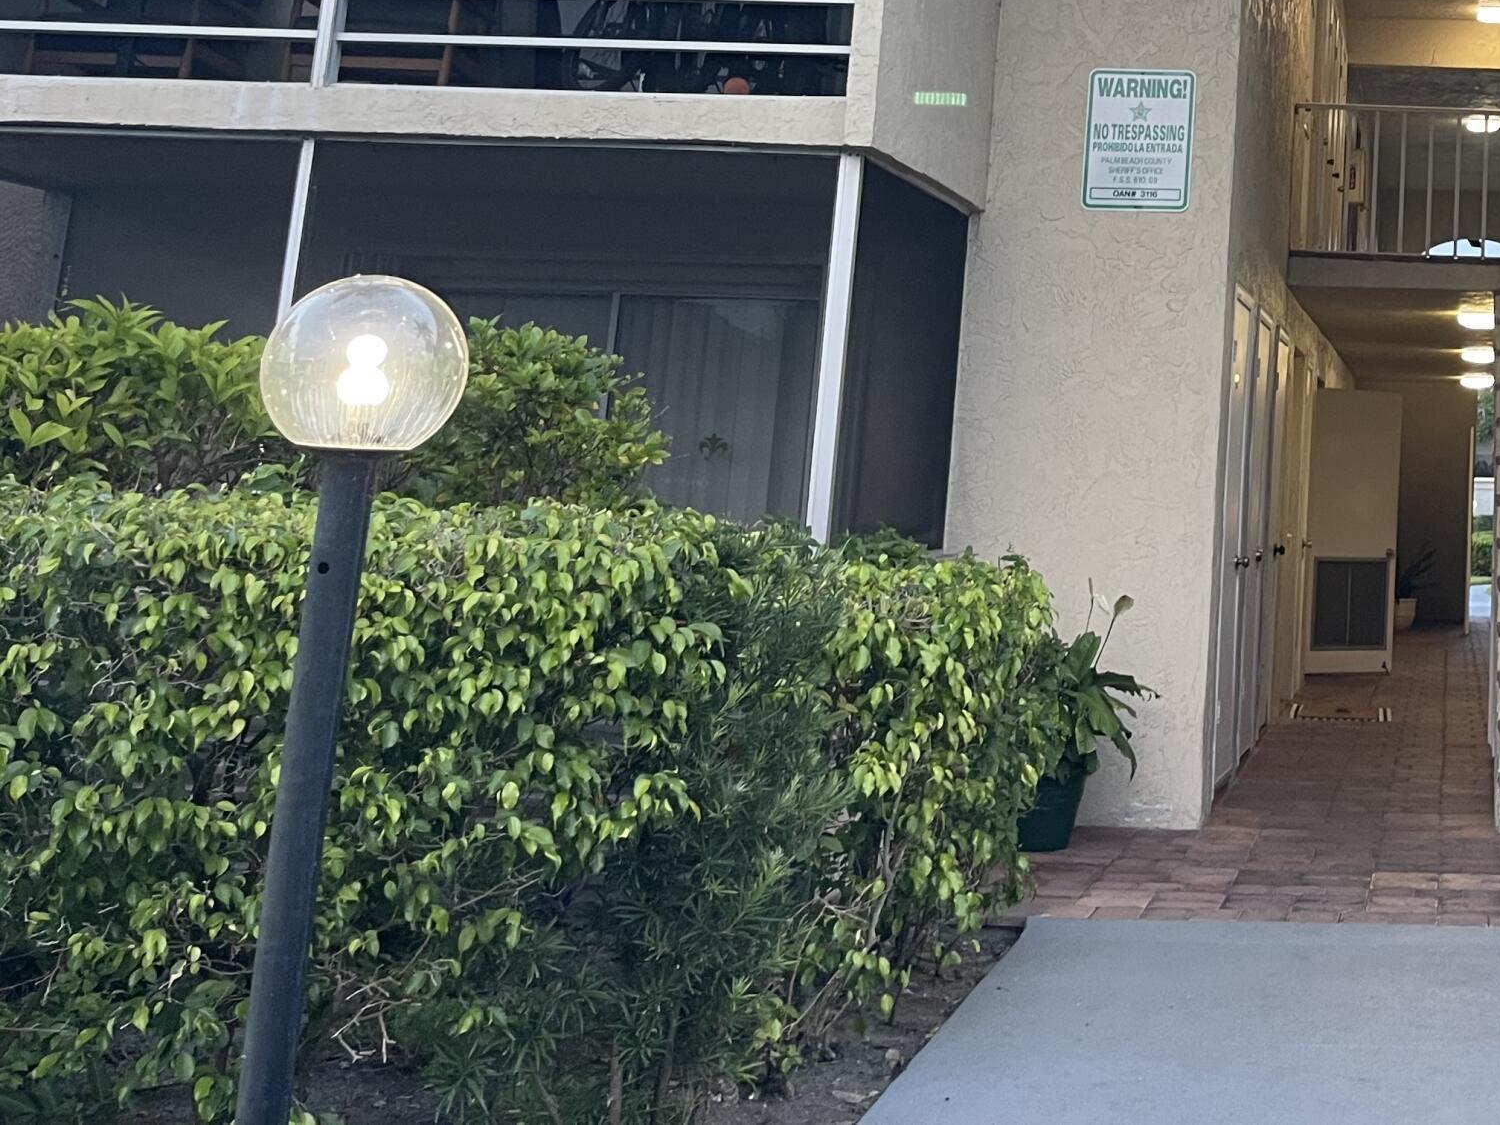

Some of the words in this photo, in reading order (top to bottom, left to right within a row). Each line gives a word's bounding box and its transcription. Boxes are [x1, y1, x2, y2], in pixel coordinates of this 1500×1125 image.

[1098, 77, 1188, 100] WARNING!
[1093, 123, 1110, 140] NO
[1111, 124, 1185, 142] TRESPASSING
[1092, 141, 1133, 153] PROHIBIDO
[1134, 142, 1145, 153] LA
[1145, 143, 1183, 154] ENTRADA
